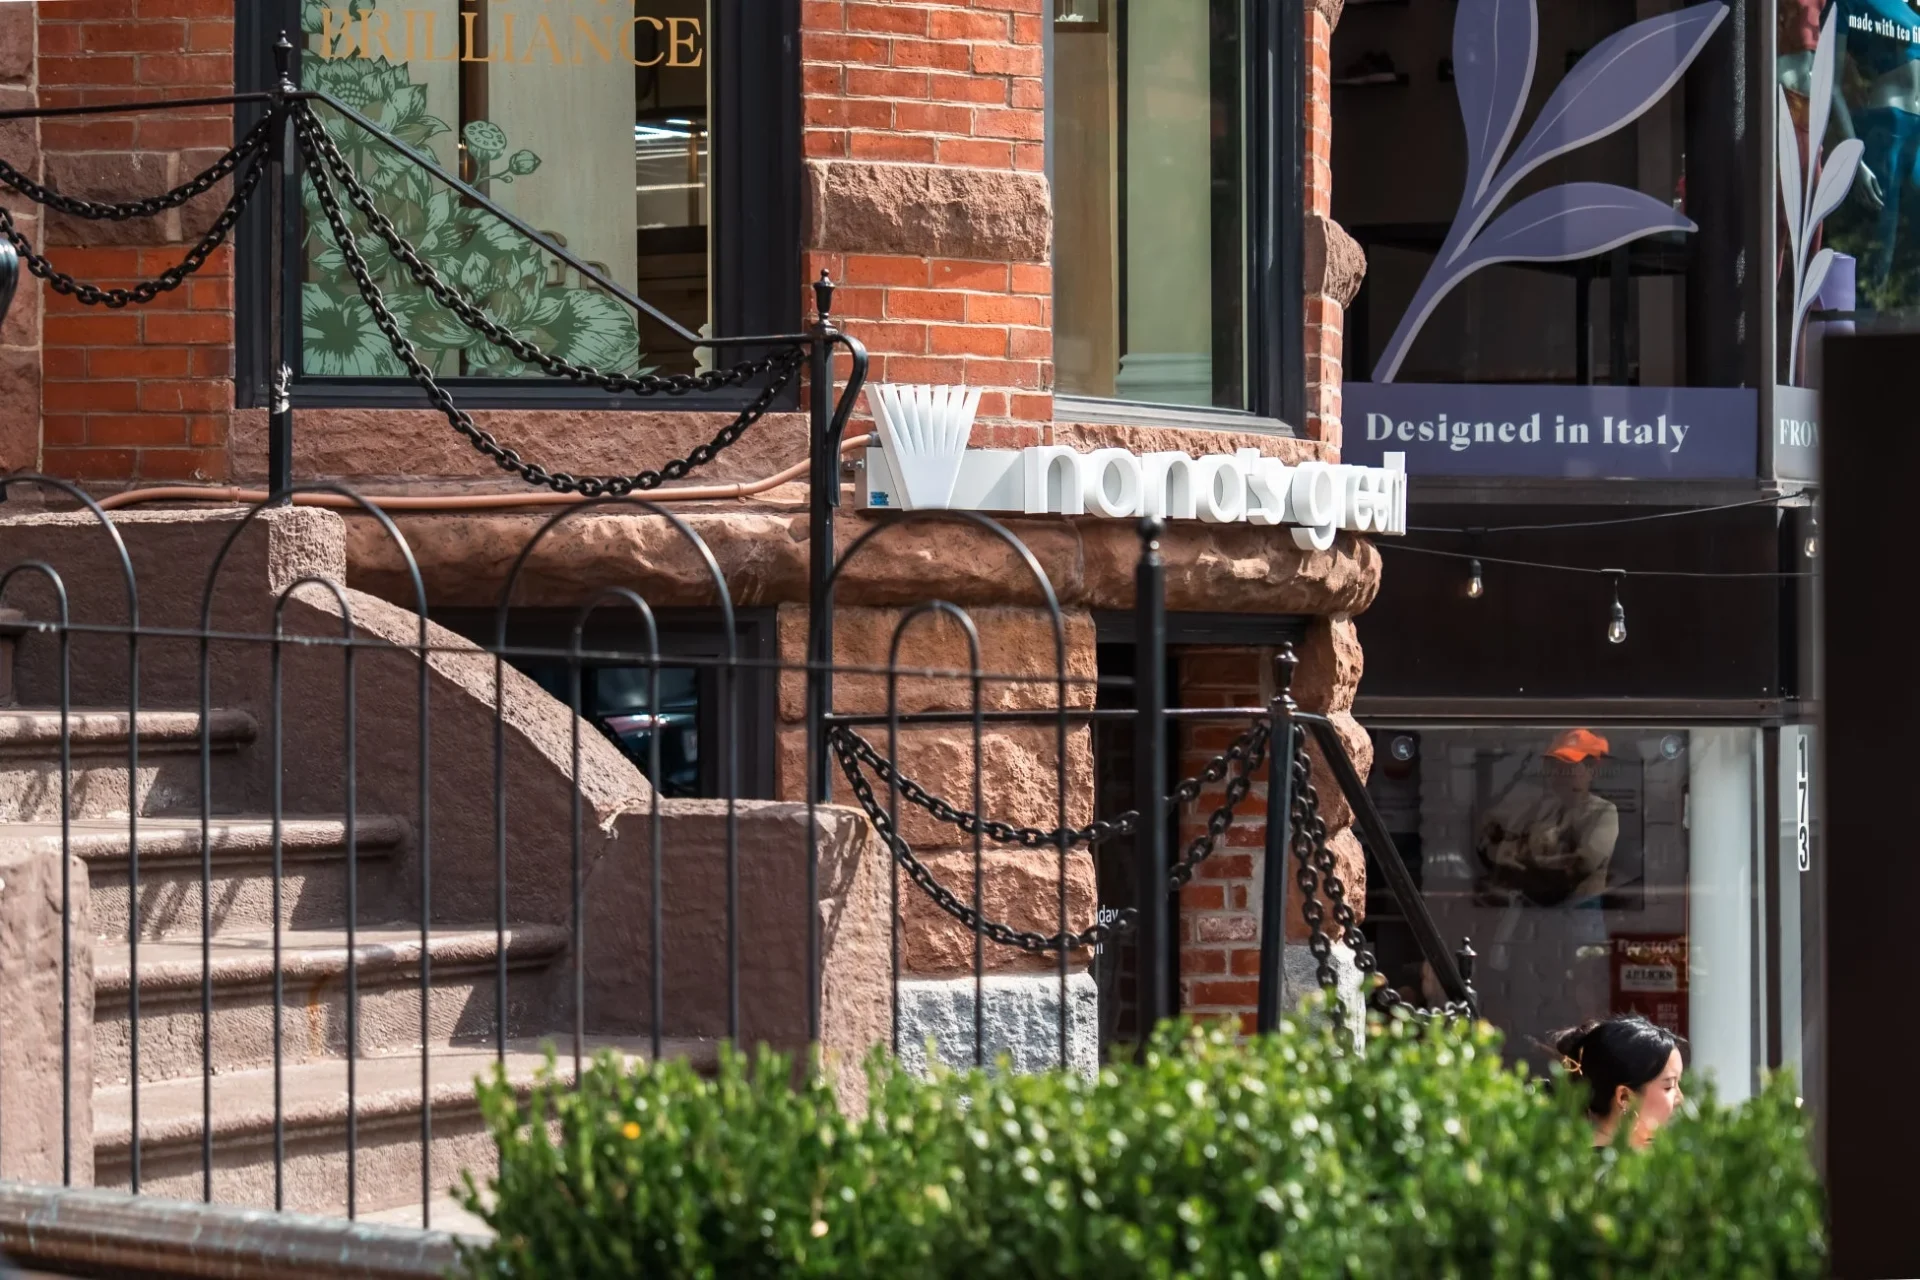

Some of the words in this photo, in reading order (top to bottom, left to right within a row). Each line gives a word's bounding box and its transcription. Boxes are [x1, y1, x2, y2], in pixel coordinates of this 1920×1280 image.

[320, 8, 703, 67] BRILLIANCE
[1848, 13, 1873, 32] made
[1875, 19, 1895, 38] with
[1366, 412, 1541, 452] Designed
[1555, 414, 1590, 444] in
[1602, 415, 1690, 453] Italy
[1798, 735, 1808, 869] 173
